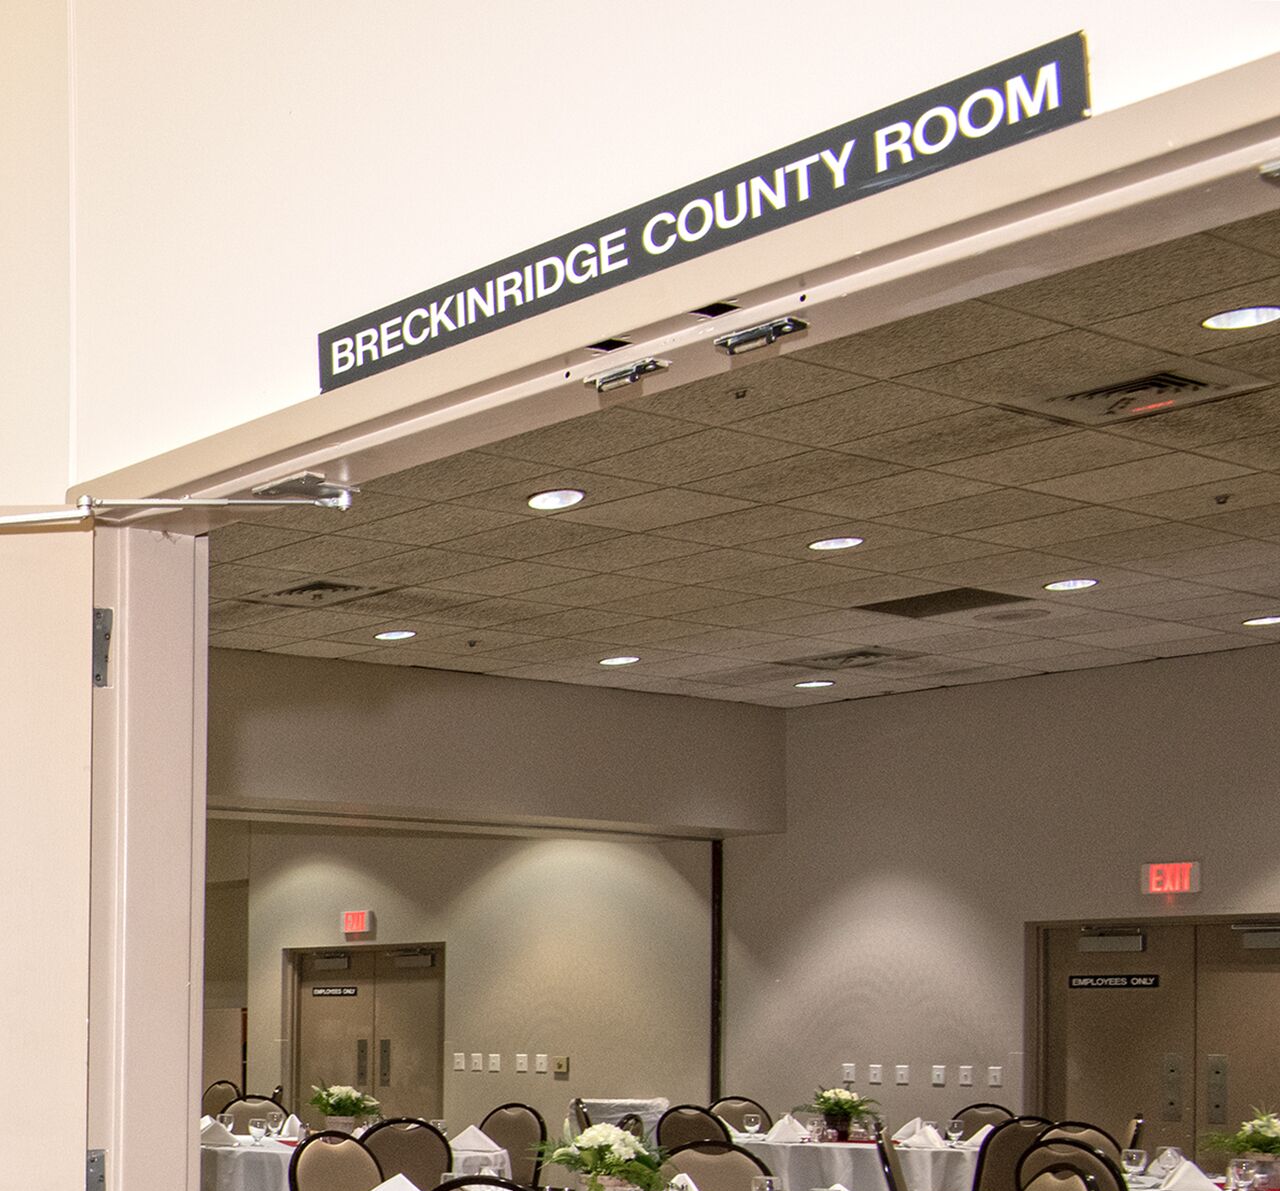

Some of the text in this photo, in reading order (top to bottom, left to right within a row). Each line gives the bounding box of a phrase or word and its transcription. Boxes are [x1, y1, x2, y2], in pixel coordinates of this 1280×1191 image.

[331, 61, 1062, 375] BRECKINRIDGE COUNTY ROOM
[1149, 862, 1192, 893] EXIT
[344, 911, 366, 932] EXIT
[1071, 976, 1156, 987] EMPLOYEES ONLY
